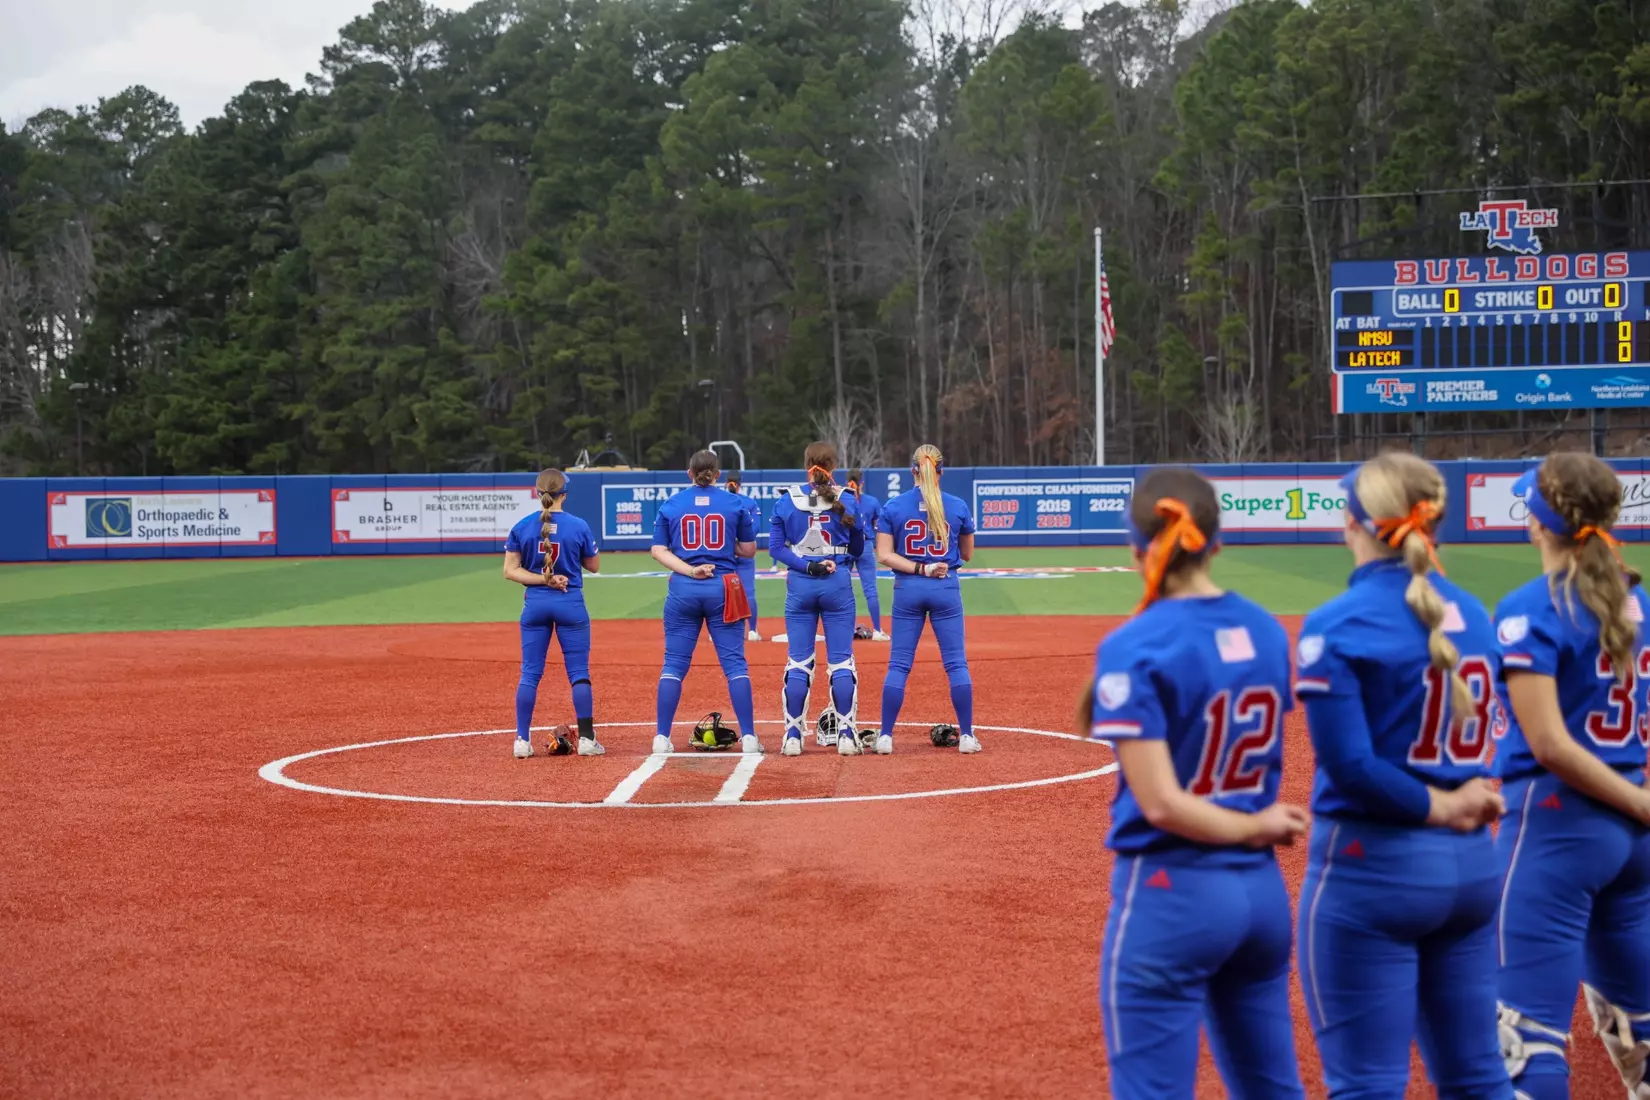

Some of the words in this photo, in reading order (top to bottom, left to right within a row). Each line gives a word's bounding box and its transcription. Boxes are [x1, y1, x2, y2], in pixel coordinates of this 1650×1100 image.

[1395, 253, 1628, 285] BULLDOGS
[1399, 294, 1442, 310] BALL
[1444, 288, 1460, 313] 0
[1475, 290, 1535, 308] STRIKE
[1537, 285, 1553, 310] 0
[1565, 288, 1602, 305] OUT
[1604, 283, 1620, 308] 0
[1336, 317, 1351, 329] AT
[1357, 316, 1381, 329] BAT
[1425, 316, 1432, 327] 1
[1442, 316, 1451, 327] 2
[1460, 316, 1468, 326] 3
[1477, 315, 1486, 325] 4
[1495, 315, 1504, 325] 5
[1514, 314, 1522, 325] 6
[1533, 314, 1541, 324] 7
[1549, 313, 1558, 324] 8
[1568, 313, 1577, 323] 9
[1584, 312, 1598, 323] 10
[1614, 311, 1622, 322] R
[1618, 321, 1632, 341] 0
[1618, 341, 1632, 362] 0
[1426, 380, 1485, 392] PREMIER
[1426, 390, 1498, 402] PARTNERS
[1515, 392, 1546, 404] Origin
[1548, 392, 1572, 402] Bank
[977, 485, 1043, 496] CONFERENCE
[1045, 484, 1131, 495] CHAMPIONSHIPS
[461, 494, 513, 502] HOMETOWN
[982, 499, 1019, 513] 2008
[1036, 499, 1071, 512] 2019
[1089, 498, 1125, 512] 2022
[1221, 493, 1284, 516] Super
[1285, 488, 1306, 520] 1
[1307, 492, 1348, 510] Foo
[425, 503, 448, 511] REAL
[450, 503, 480, 511] ESTATE
[137, 508, 214, 523] Orthopaedic
[219, 508, 229, 520] &
[359, 515, 418, 524] BRASHER
[982, 515, 1016, 528] 2017
[138, 525, 179, 540] Sports
[183, 524, 241, 536] Medicine
[680, 513, 725, 551] 00
[1406, 655, 1495, 766] 18
[1186, 685, 1282, 800] 12
